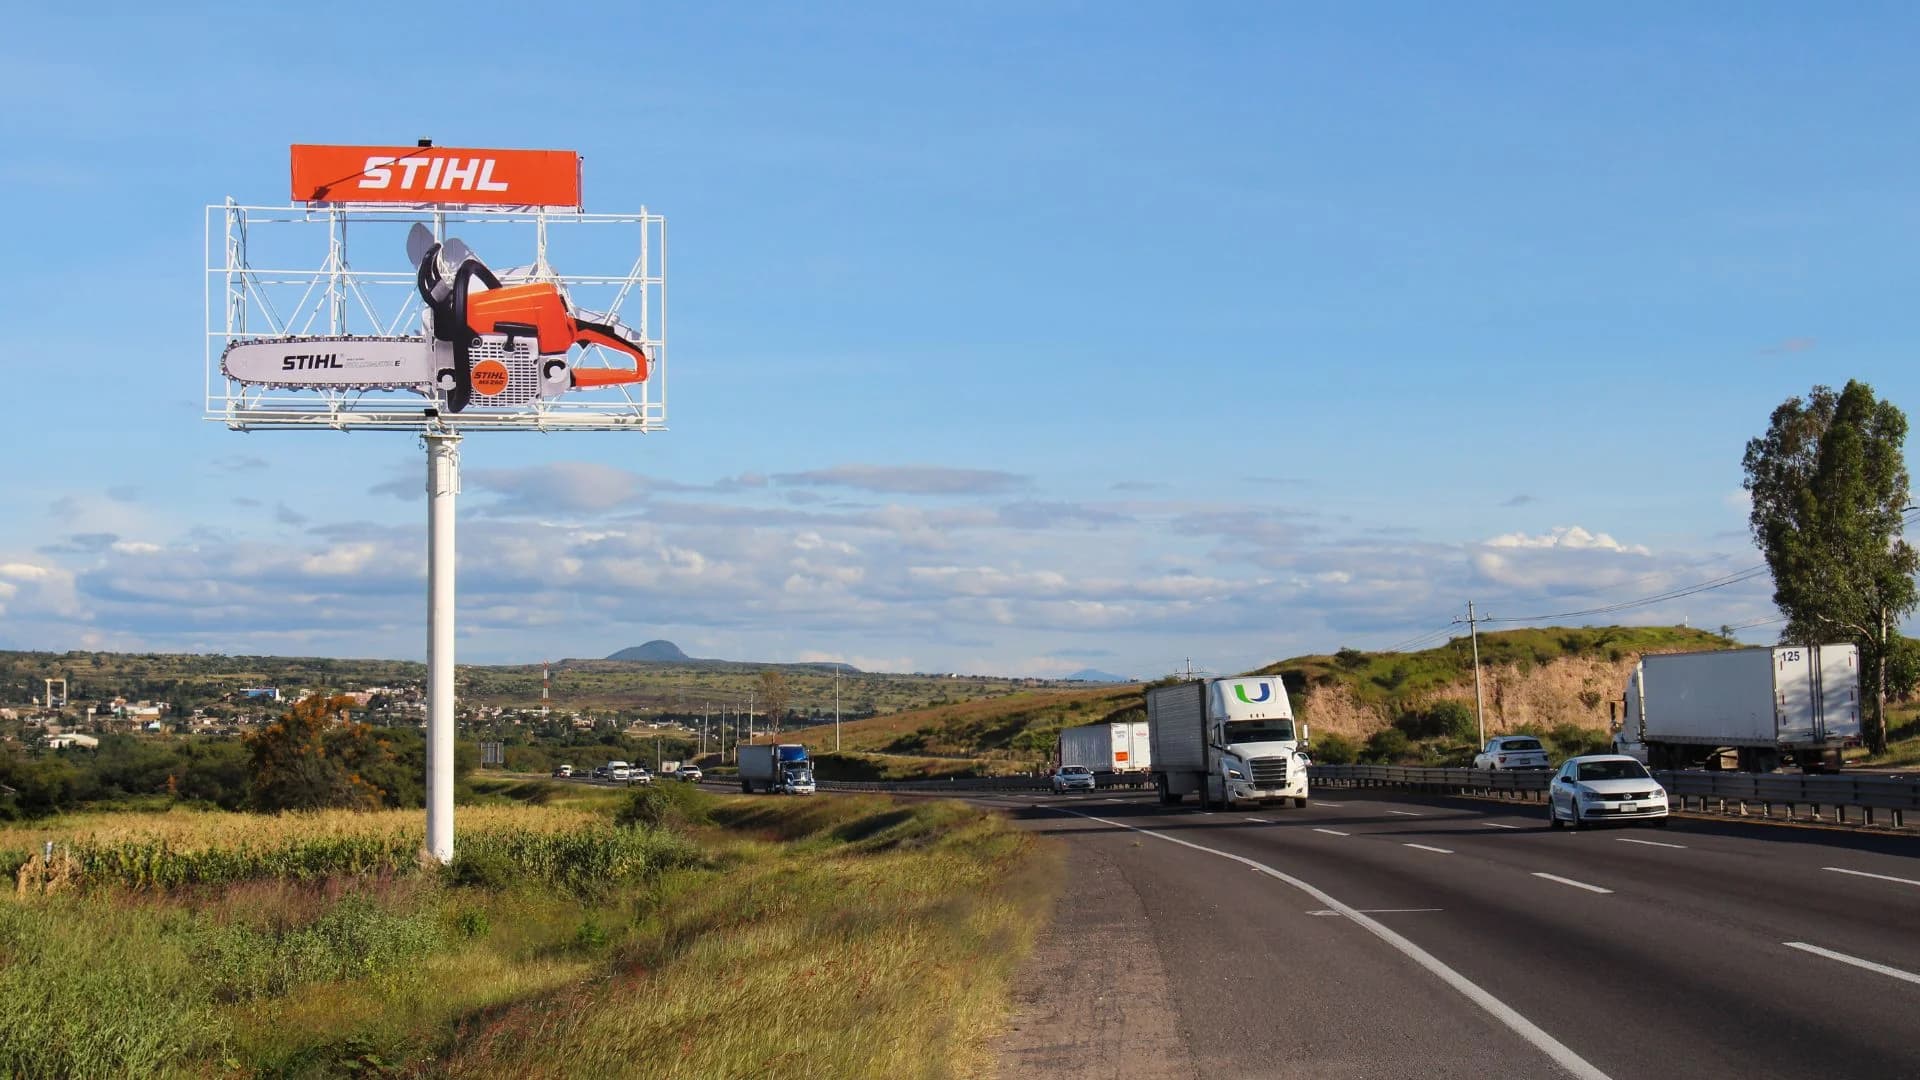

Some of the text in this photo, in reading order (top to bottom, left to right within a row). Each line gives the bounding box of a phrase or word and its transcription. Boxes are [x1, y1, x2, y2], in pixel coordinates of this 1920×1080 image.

[358, 156, 509, 192] STIHL
[282, 353, 343, 371] STIHL
[473, 371, 505, 380] STIHL
[1781, 651, 1800, 662] 125
